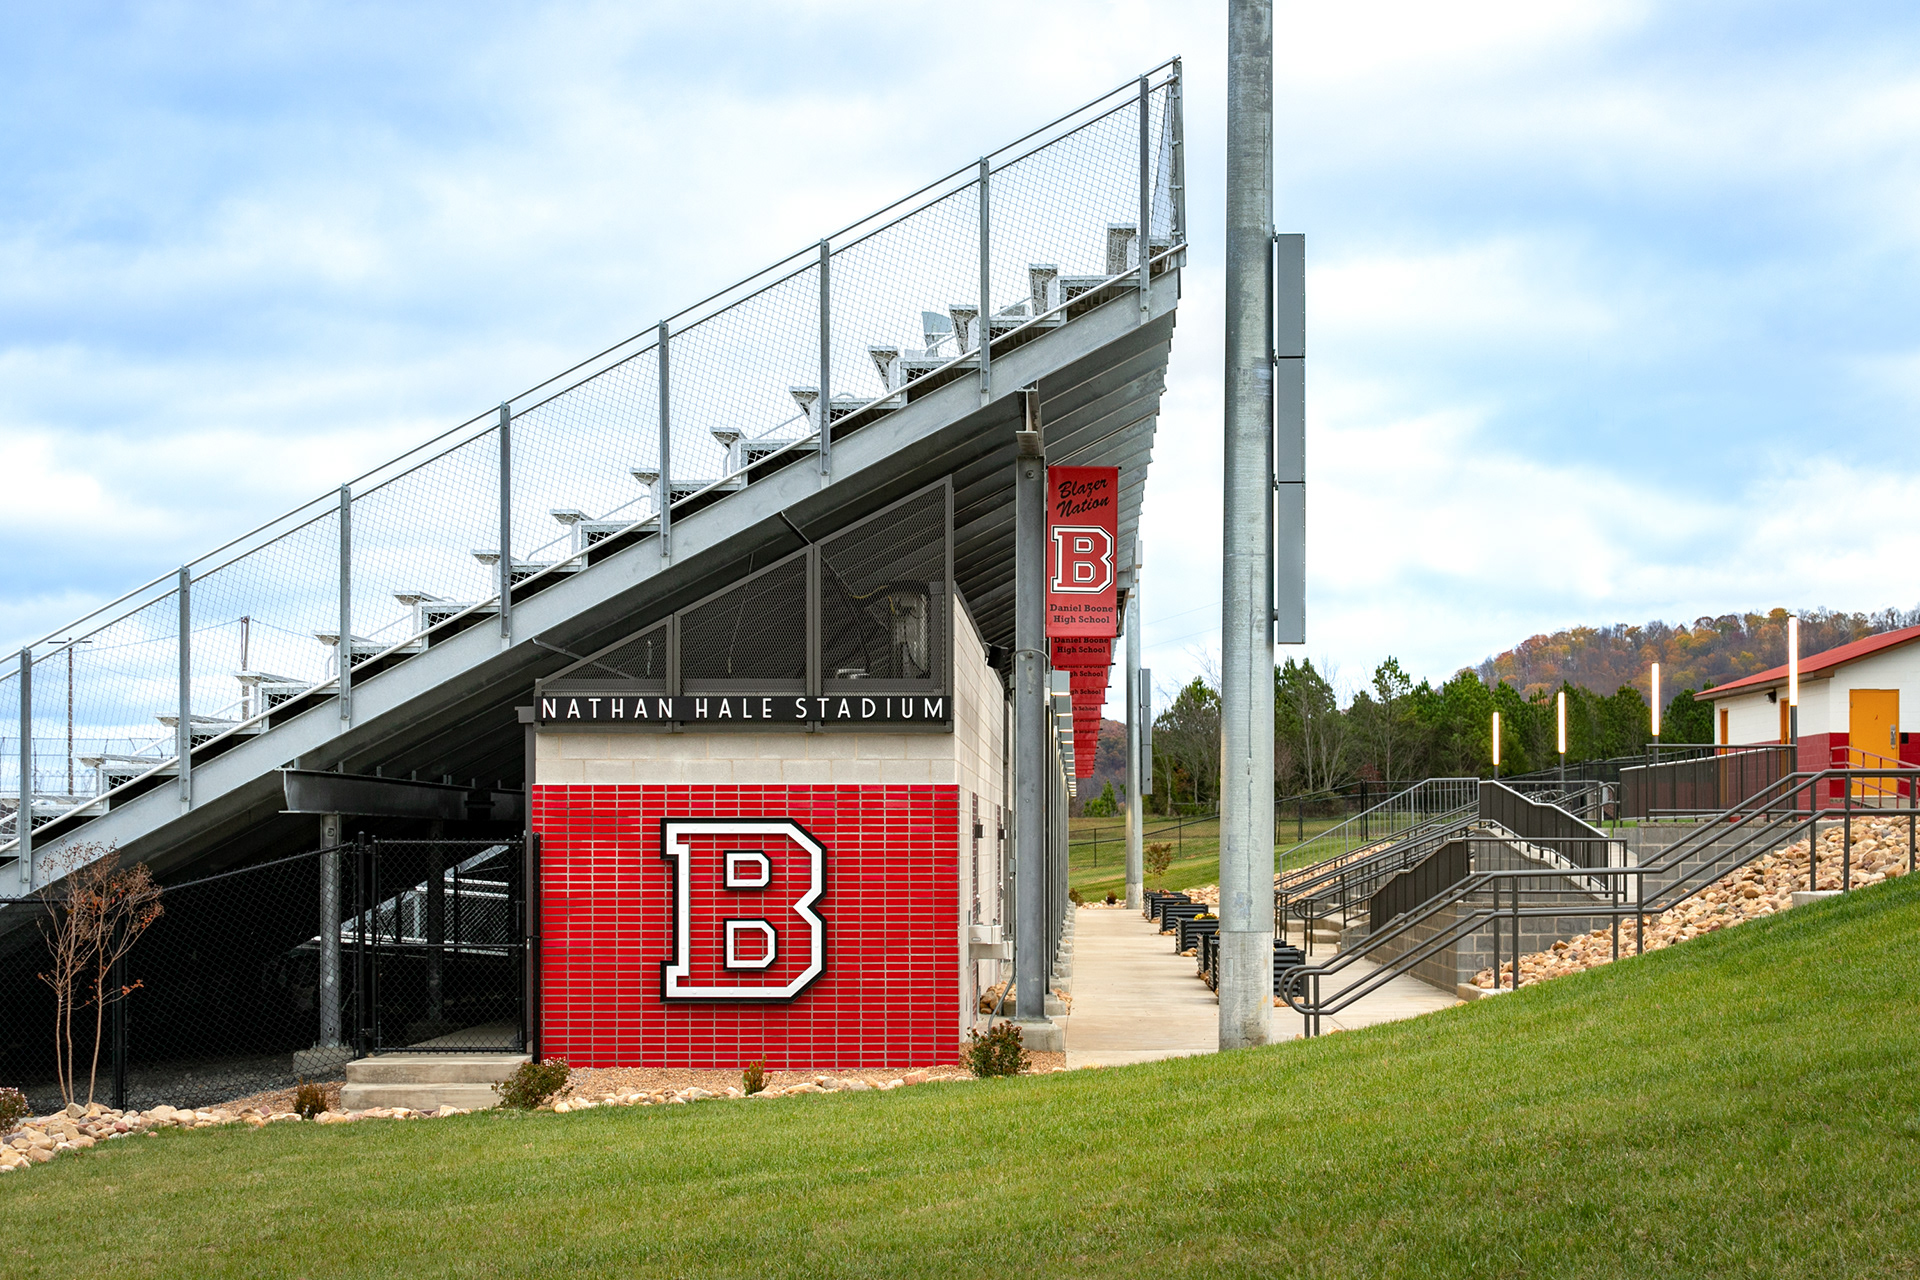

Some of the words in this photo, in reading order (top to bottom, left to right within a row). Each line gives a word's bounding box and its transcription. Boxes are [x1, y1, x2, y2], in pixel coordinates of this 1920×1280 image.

[1058, 478, 1109, 499] Blazer
[1056, 496, 1110, 518] Nation
[1051, 525, 1114, 594] B
[1049, 603, 1082, 613] Daniel
[1084, 604, 1114, 613] Boone
[1053, 615, 1077, 625] High
[1078, 615, 1110, 624] School
[1057, 646, 1077, 655] High
[542, 697, 674, 719] NATHAN
[695, 697, 773, 719] HALE
[794, 697, 944, 719] STADIUM
[660, 818, 827, 1003] B
